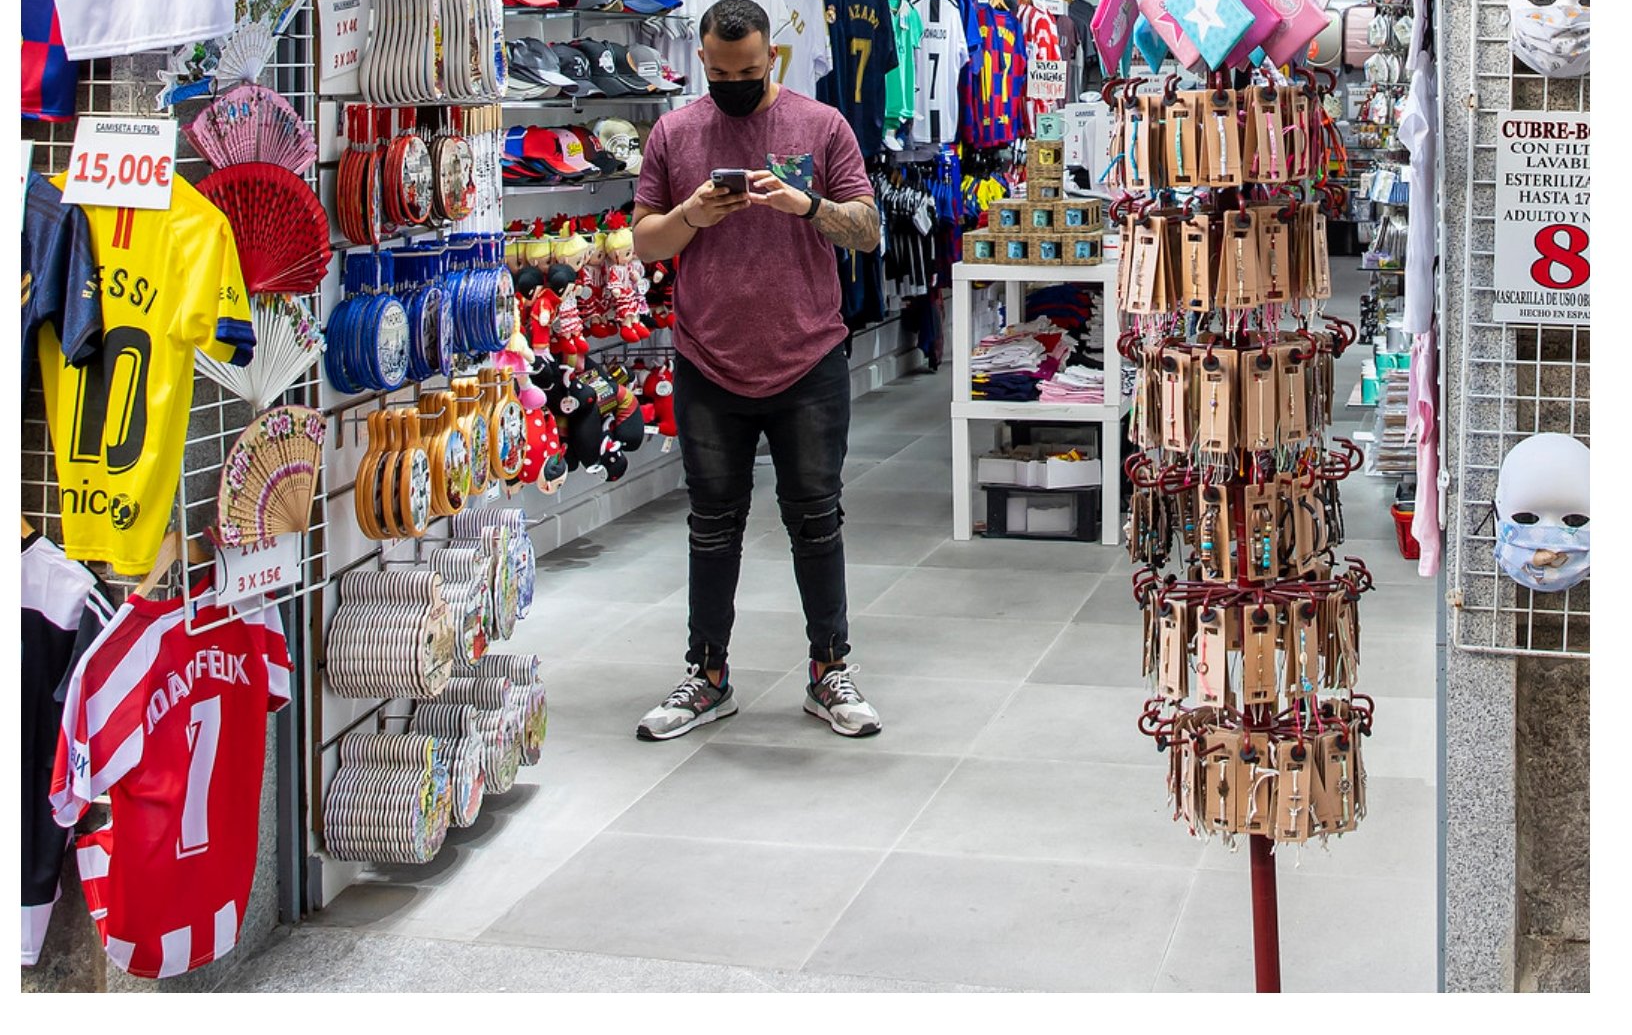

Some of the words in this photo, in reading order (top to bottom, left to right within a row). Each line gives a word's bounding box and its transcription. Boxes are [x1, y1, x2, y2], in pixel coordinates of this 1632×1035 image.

[850, 38, 872, 103] 7
[928, 53, 939, 100] 7
[96, 122, 131, 133] CAMISETA
[133, 124, 160, 135] FUTBOL
[1502, 121, 1590, 140] CUBRE-B
[1510, 143, 1549, 155] CON
[74, 152, 172, 189] 15,00€
[1519, 192, 1570, 205] HASTA
[1504, 210, 1566, 223] ADULTO
[1566, 211, 1579, 222] Y
[1530, 223, 1590, 290] 8
[98, 266, 158, 315] SSI
[1494, 291, 1546, 306] MASCARILLA
[1546, 292, 1558, 306] DE
[1559, 292, 1576, 306] USO
[1519, 308, 1552, 319] HECHO
[1552, 309, 1566, 319] EN
[69, 325, 151, 475] 10
[60, 480, 109, 515] nic
[238, 576, 245, 593] 3
[249, 573, 256, 590] X
[260, 566, 281, 586] 15€
[176, 694, 222, 860] 7
